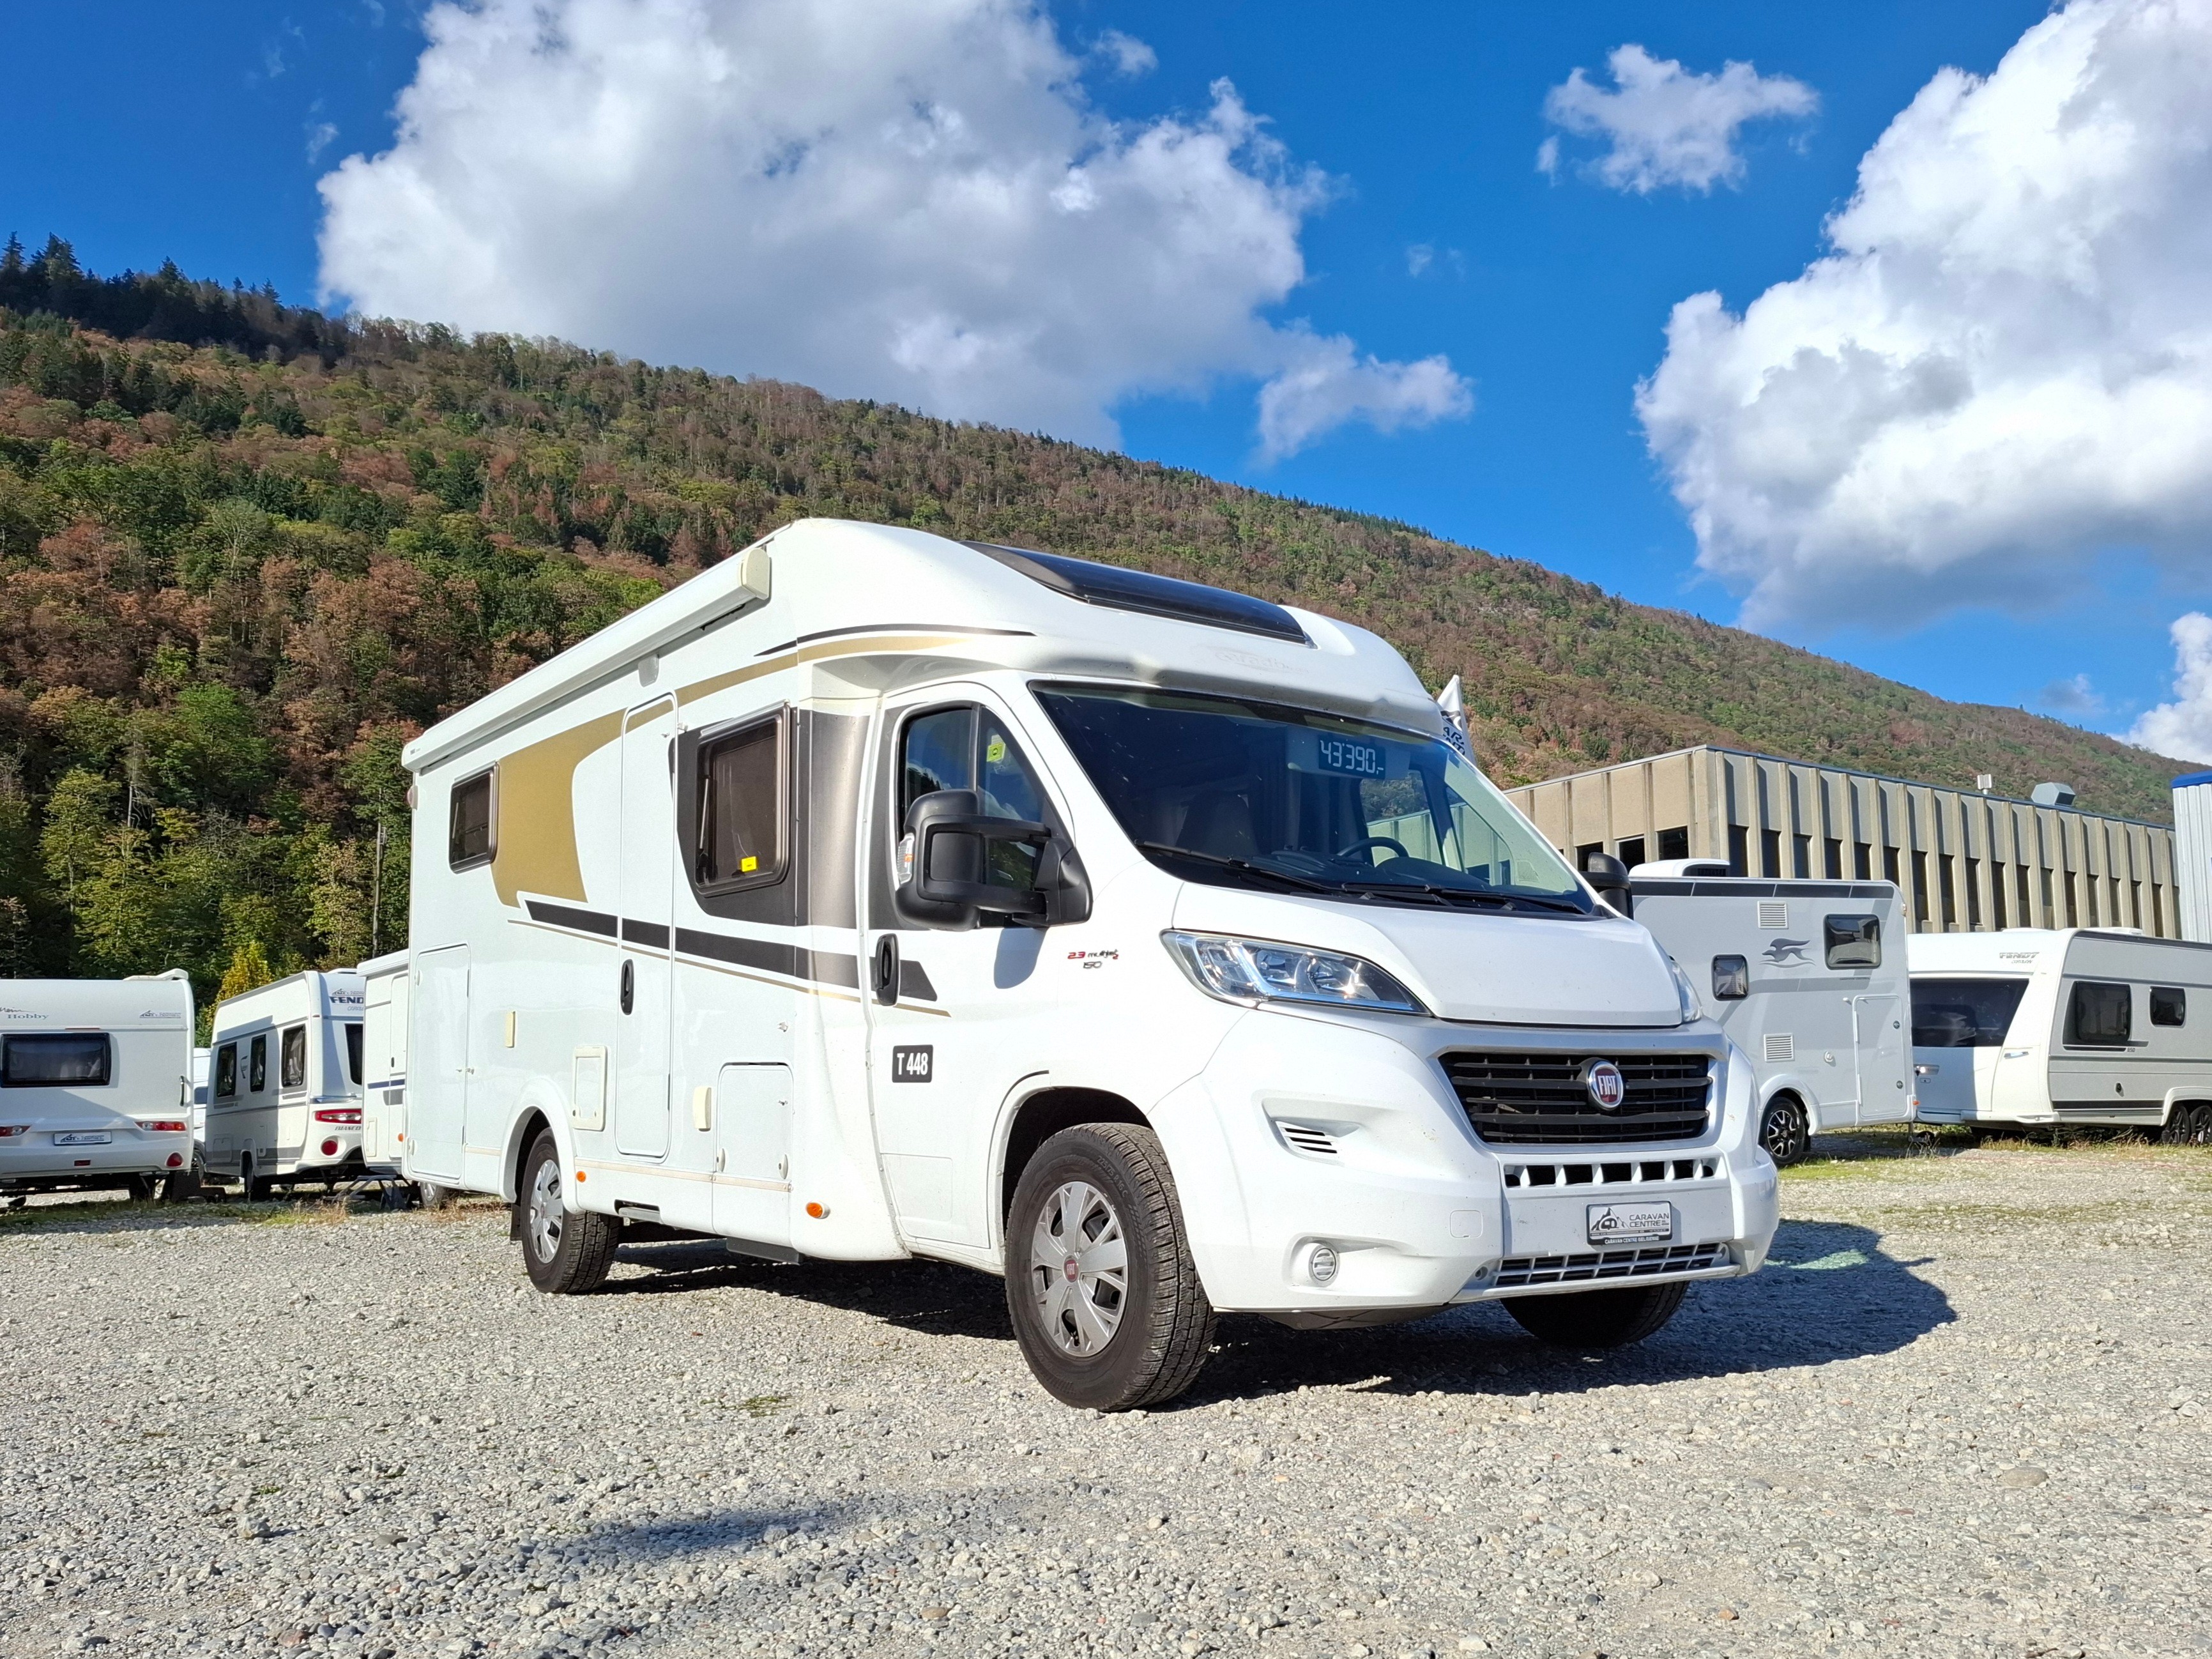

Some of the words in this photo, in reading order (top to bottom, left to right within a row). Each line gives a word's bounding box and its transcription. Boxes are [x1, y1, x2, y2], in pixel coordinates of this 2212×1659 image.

[896, 1053, 905, 1075] T
[906, 1052, 928, 1075] 448
[1597, 1075, 1617, 1095] FIAT
